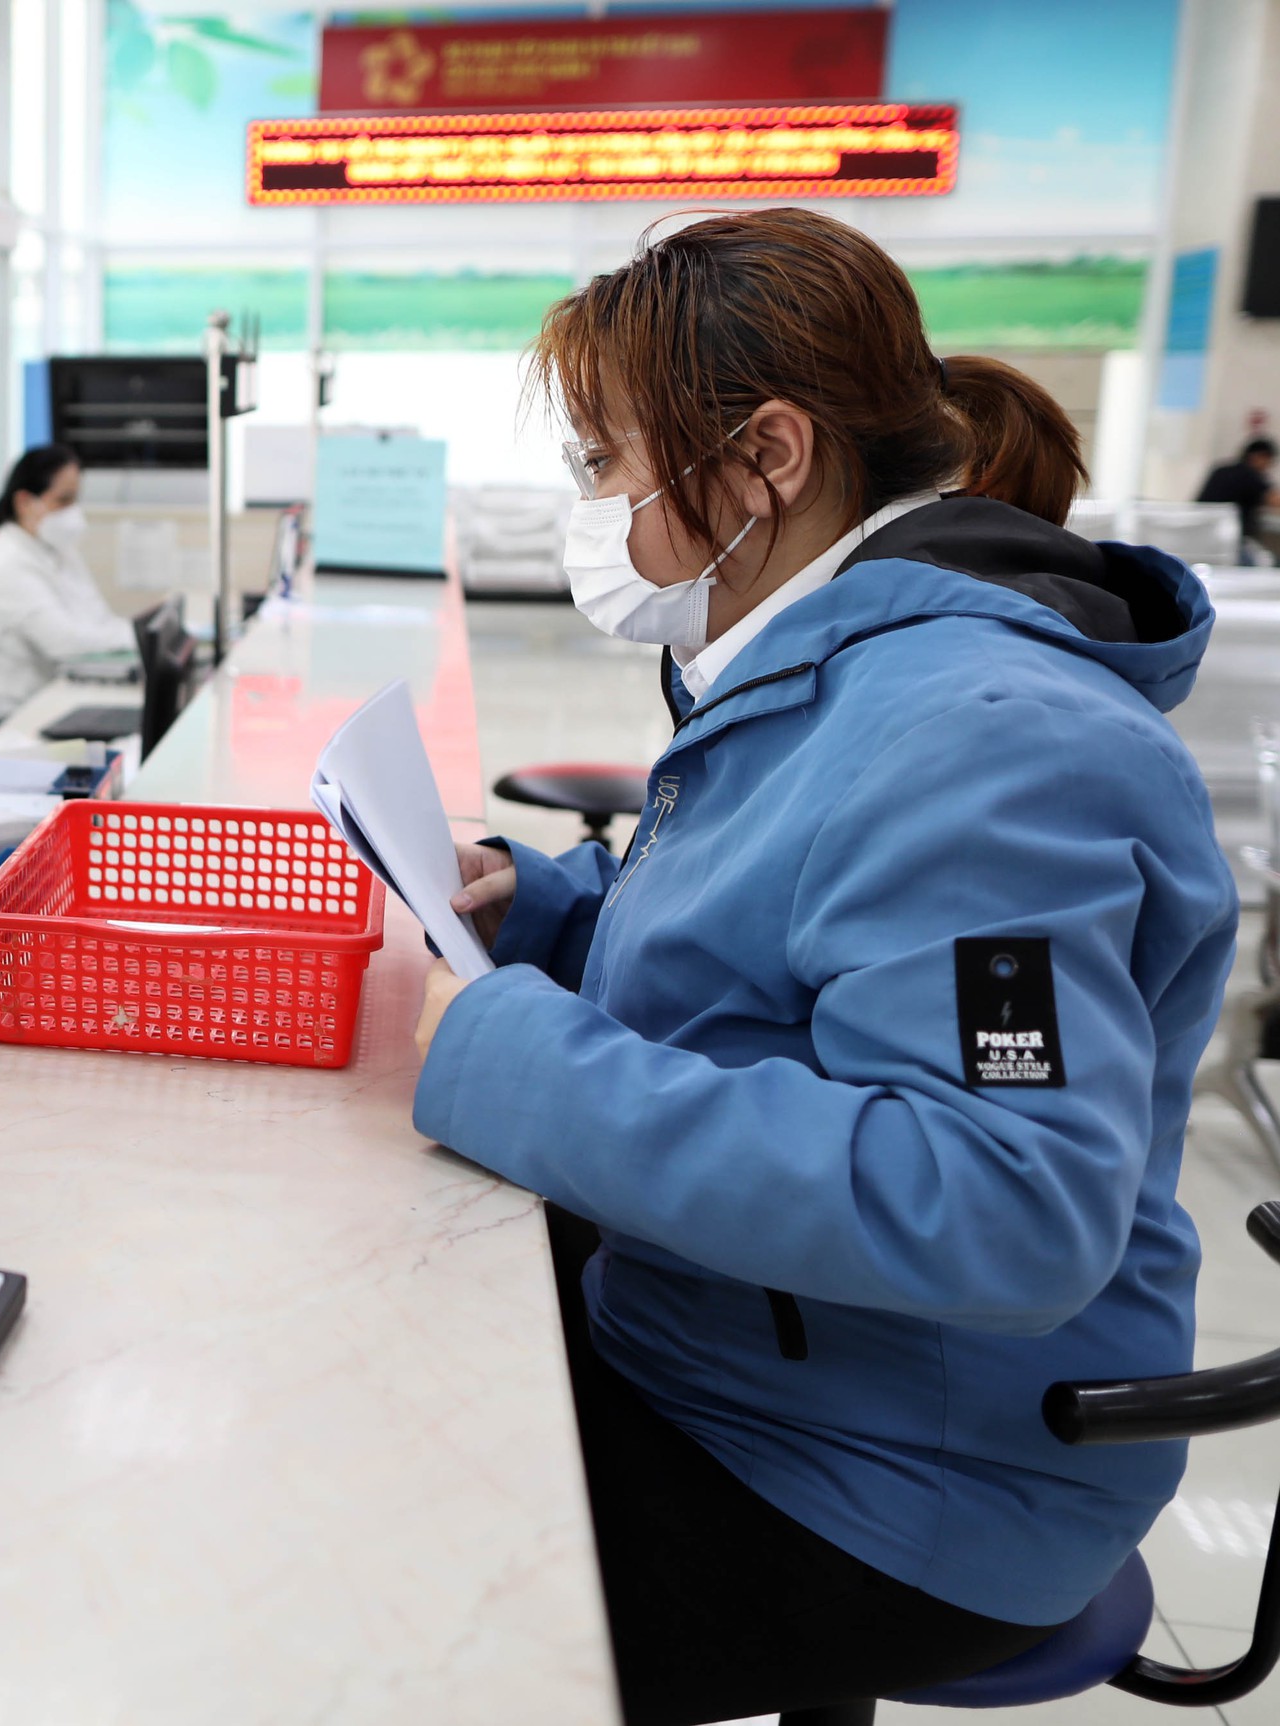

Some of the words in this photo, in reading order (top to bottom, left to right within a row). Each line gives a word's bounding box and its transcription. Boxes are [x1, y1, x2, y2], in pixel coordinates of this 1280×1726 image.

[976, 1030, 1045, 1048] POKER
[989, 1050, 1036, 1061] U.S.A
[1016, 1062, 1052, 1072] STYLE
[981, 1071, 1049, 1080] COLLECTION
